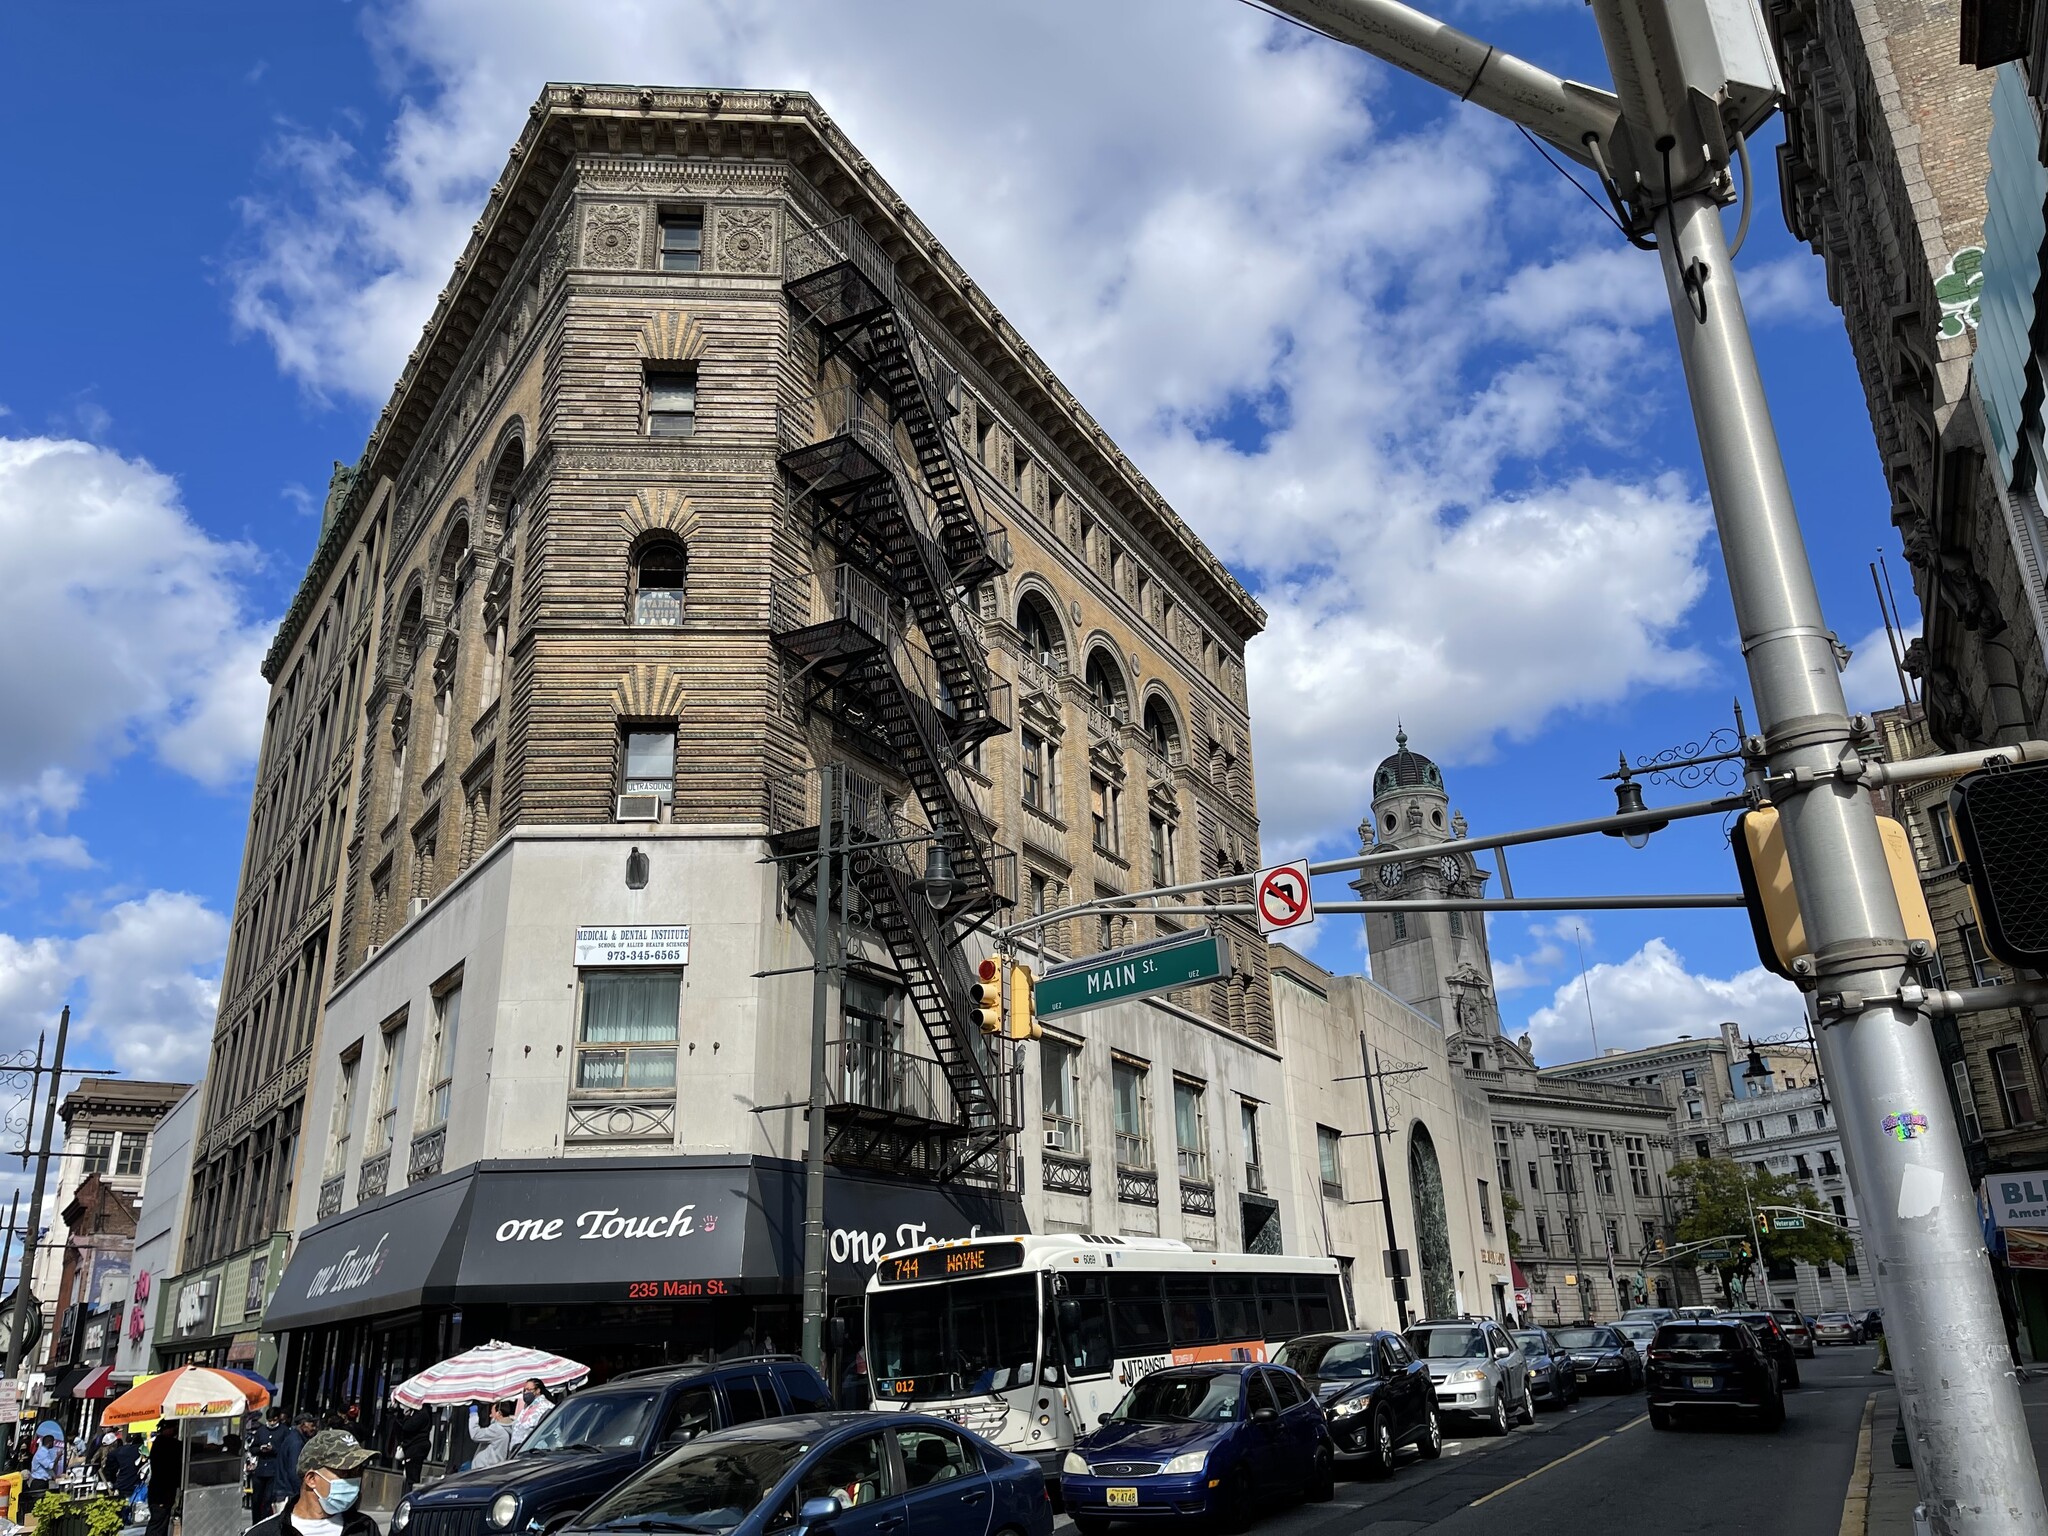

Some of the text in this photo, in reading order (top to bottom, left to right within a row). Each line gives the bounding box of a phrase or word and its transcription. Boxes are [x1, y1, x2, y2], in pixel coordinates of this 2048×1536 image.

[627, 782, 672, 791] ULTRASOUND
[577, 929, 689, 941] MEDICAL & DENTAL INSTITUTE
[607, 950, 680, 961] 973-345-6565
[1087, 958, 1158, 995] MAIN St.
[1188, 969, 1200, 979] UEZ
[1052, 1001, 1062, 1011] UEZ
[495, 1207, 696, 1242] one Touch
[830, 1228, 887, 1265] one
[306, 1264, 337, 1299] one
[330, 1232, 390, 1293] Touch
[894, 1250, 985, 1281] 744 WAYNE
[629, 1279, 729, 1298] 235 Main St.
[896, 1380, 915, 1393] 012
